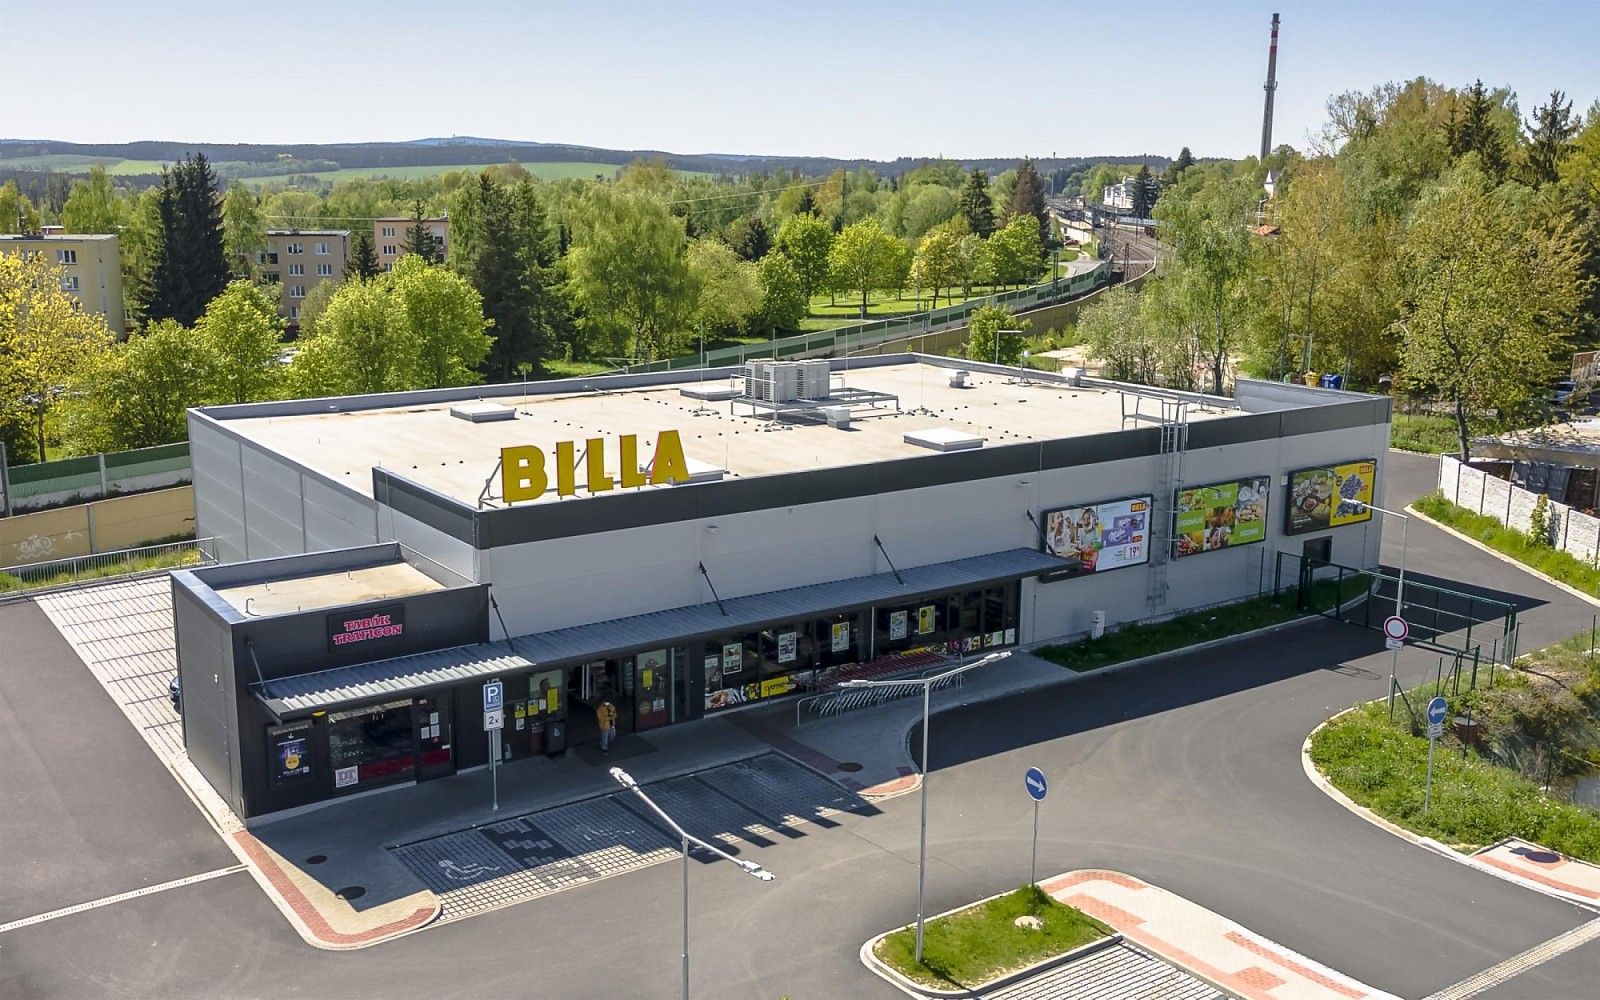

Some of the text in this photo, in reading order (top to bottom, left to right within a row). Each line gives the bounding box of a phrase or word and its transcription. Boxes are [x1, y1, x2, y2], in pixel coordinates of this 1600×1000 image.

[501, 430, 691, 503] BILLA
[344, 614, 391, 631] TABÁK
[333, 624, 402, 645] TRAFICON
[487, 686, 499, 703] P
